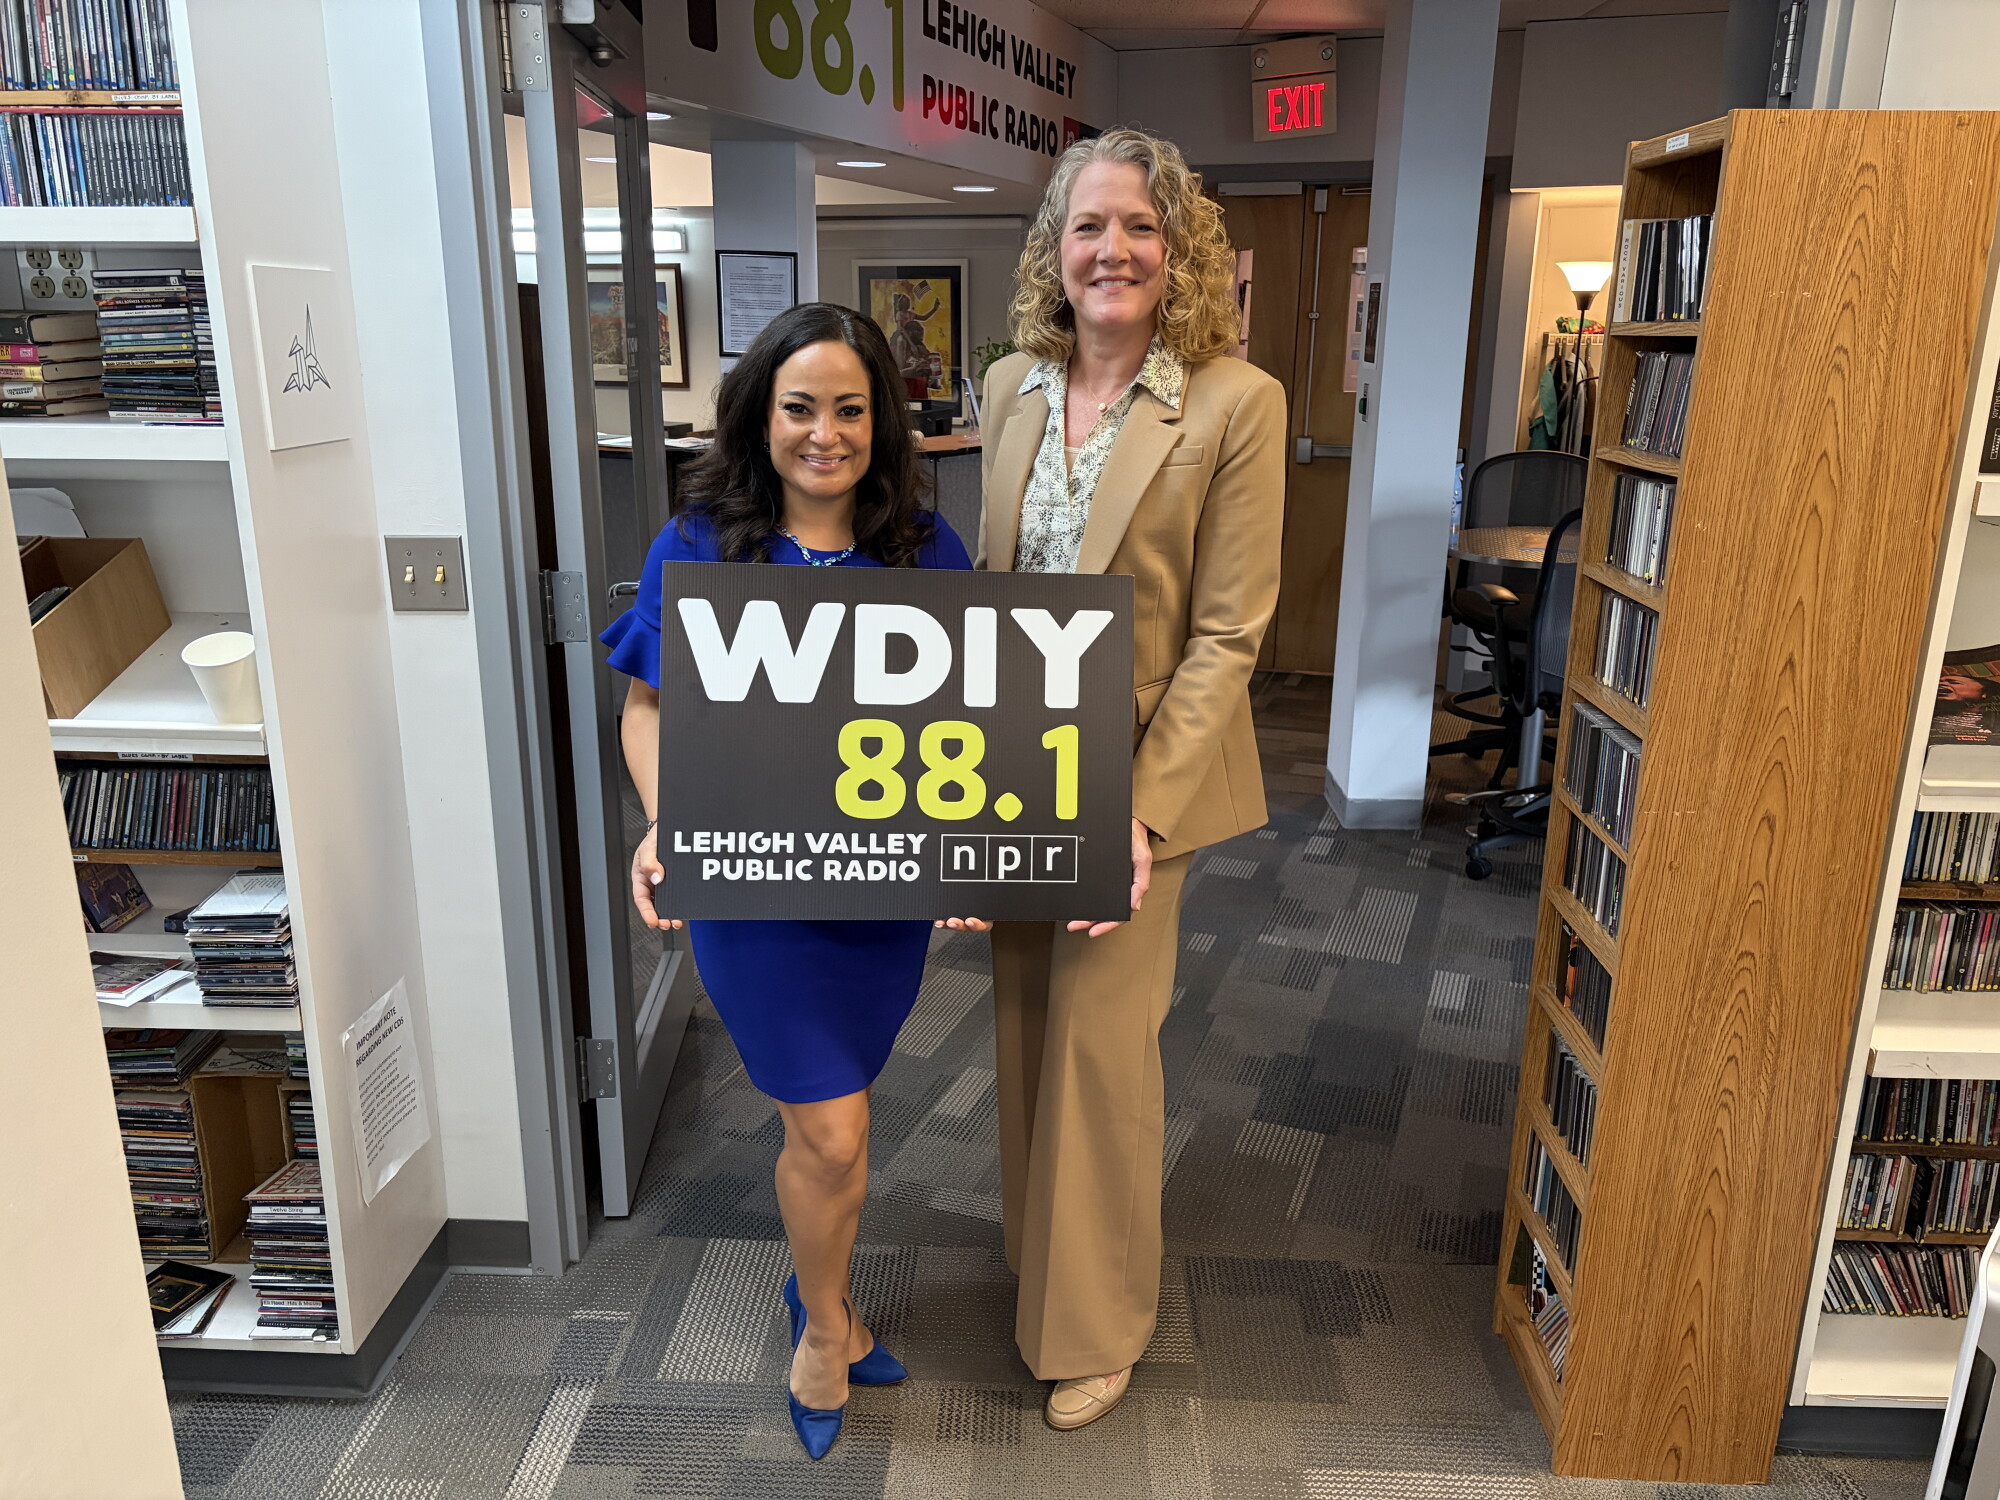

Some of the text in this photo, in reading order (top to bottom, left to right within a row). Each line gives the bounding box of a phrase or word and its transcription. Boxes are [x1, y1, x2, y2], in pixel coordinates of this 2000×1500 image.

[922, 0, 1077, 100] LEHIGH VALLEY
[922, 73, 1059, 158] PUBLIC RADIO
[1267, 82, 1325, 132] EXIT
[1618, 266, 1627, 308] VARIOUS
[677, 597, 1115, 709] WDIY
[835, 718, 1080, 822] 88.1
[673, 831, 928, 855] LEHIGH VALLEY
[953, 845, 1063, 880] npr
[702, 858, 921, 882] PUBLIC RADIO
[356, 1006, 397, 1051] IMPORTANT NOTE
[356, 1035, 382, 1068] REGARDING
[381, 1024, 394, 1041] NEW
